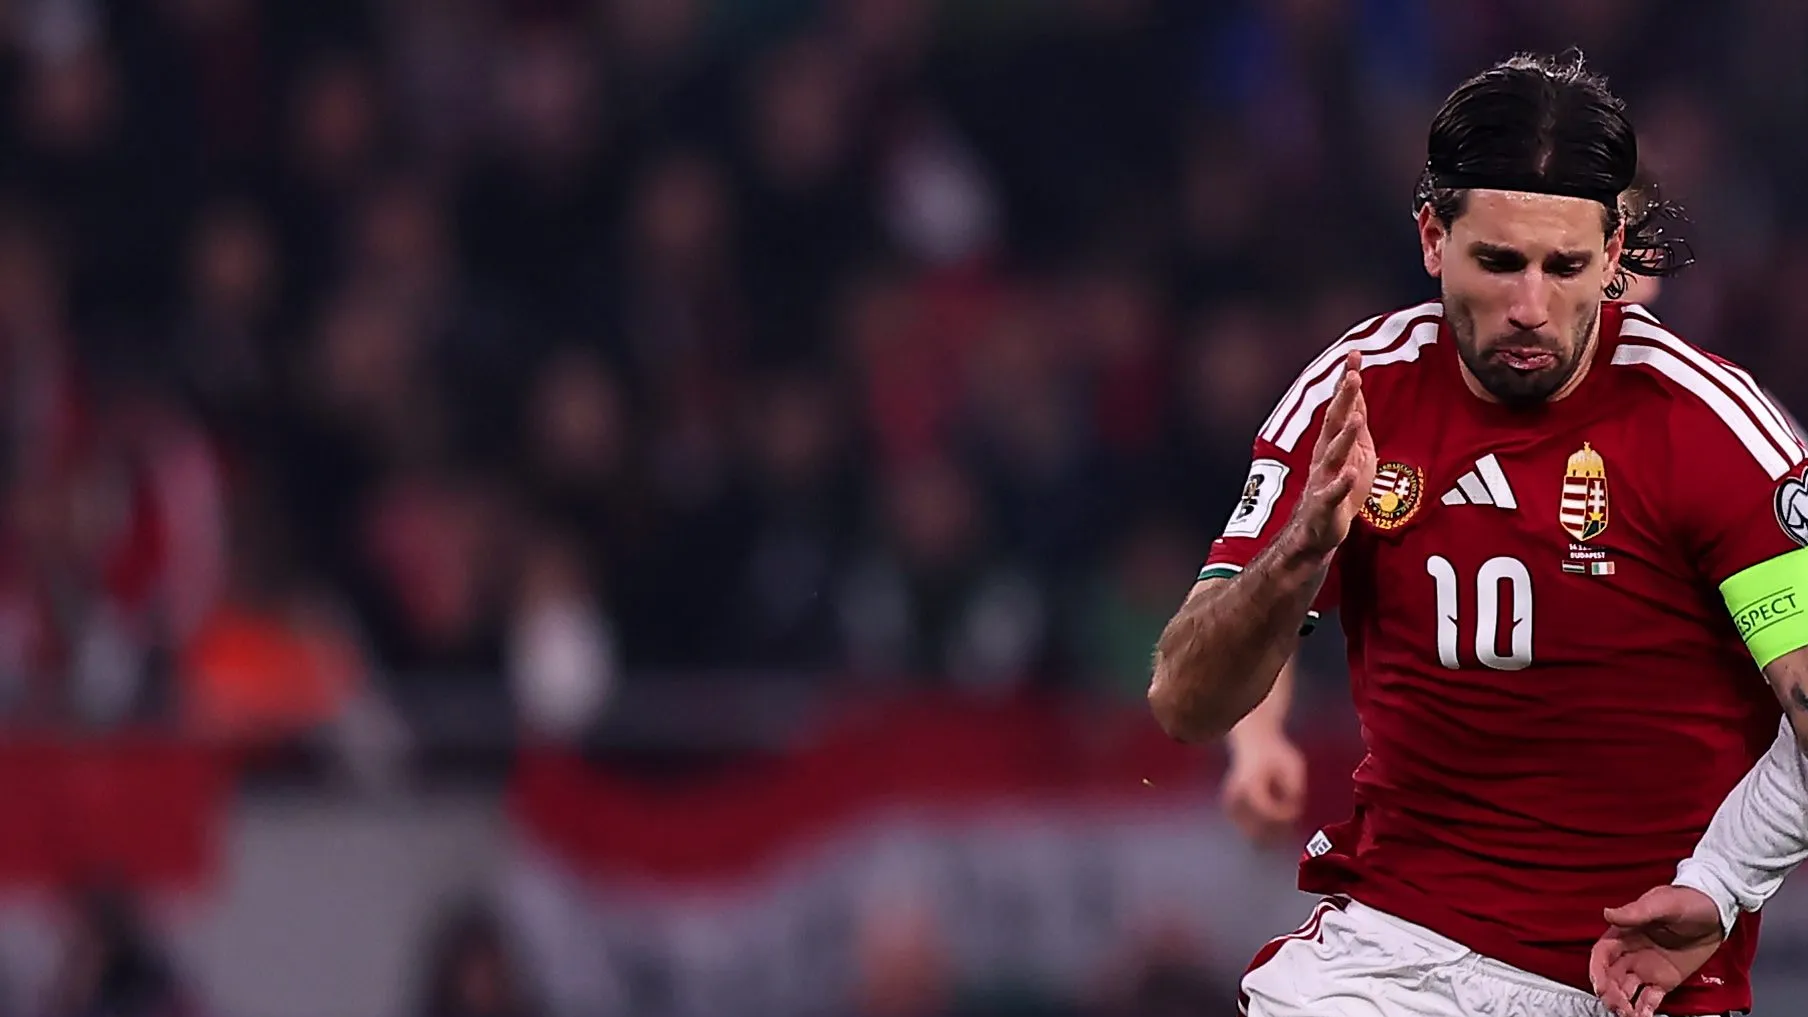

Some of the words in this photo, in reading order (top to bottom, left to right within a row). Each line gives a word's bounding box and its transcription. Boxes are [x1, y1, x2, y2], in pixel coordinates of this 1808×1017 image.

[1375, 517, 1393, 530] 125
[1570, 551, 1606, 559] BUDAPEST
[1426, 555, 1533, 671] 10
